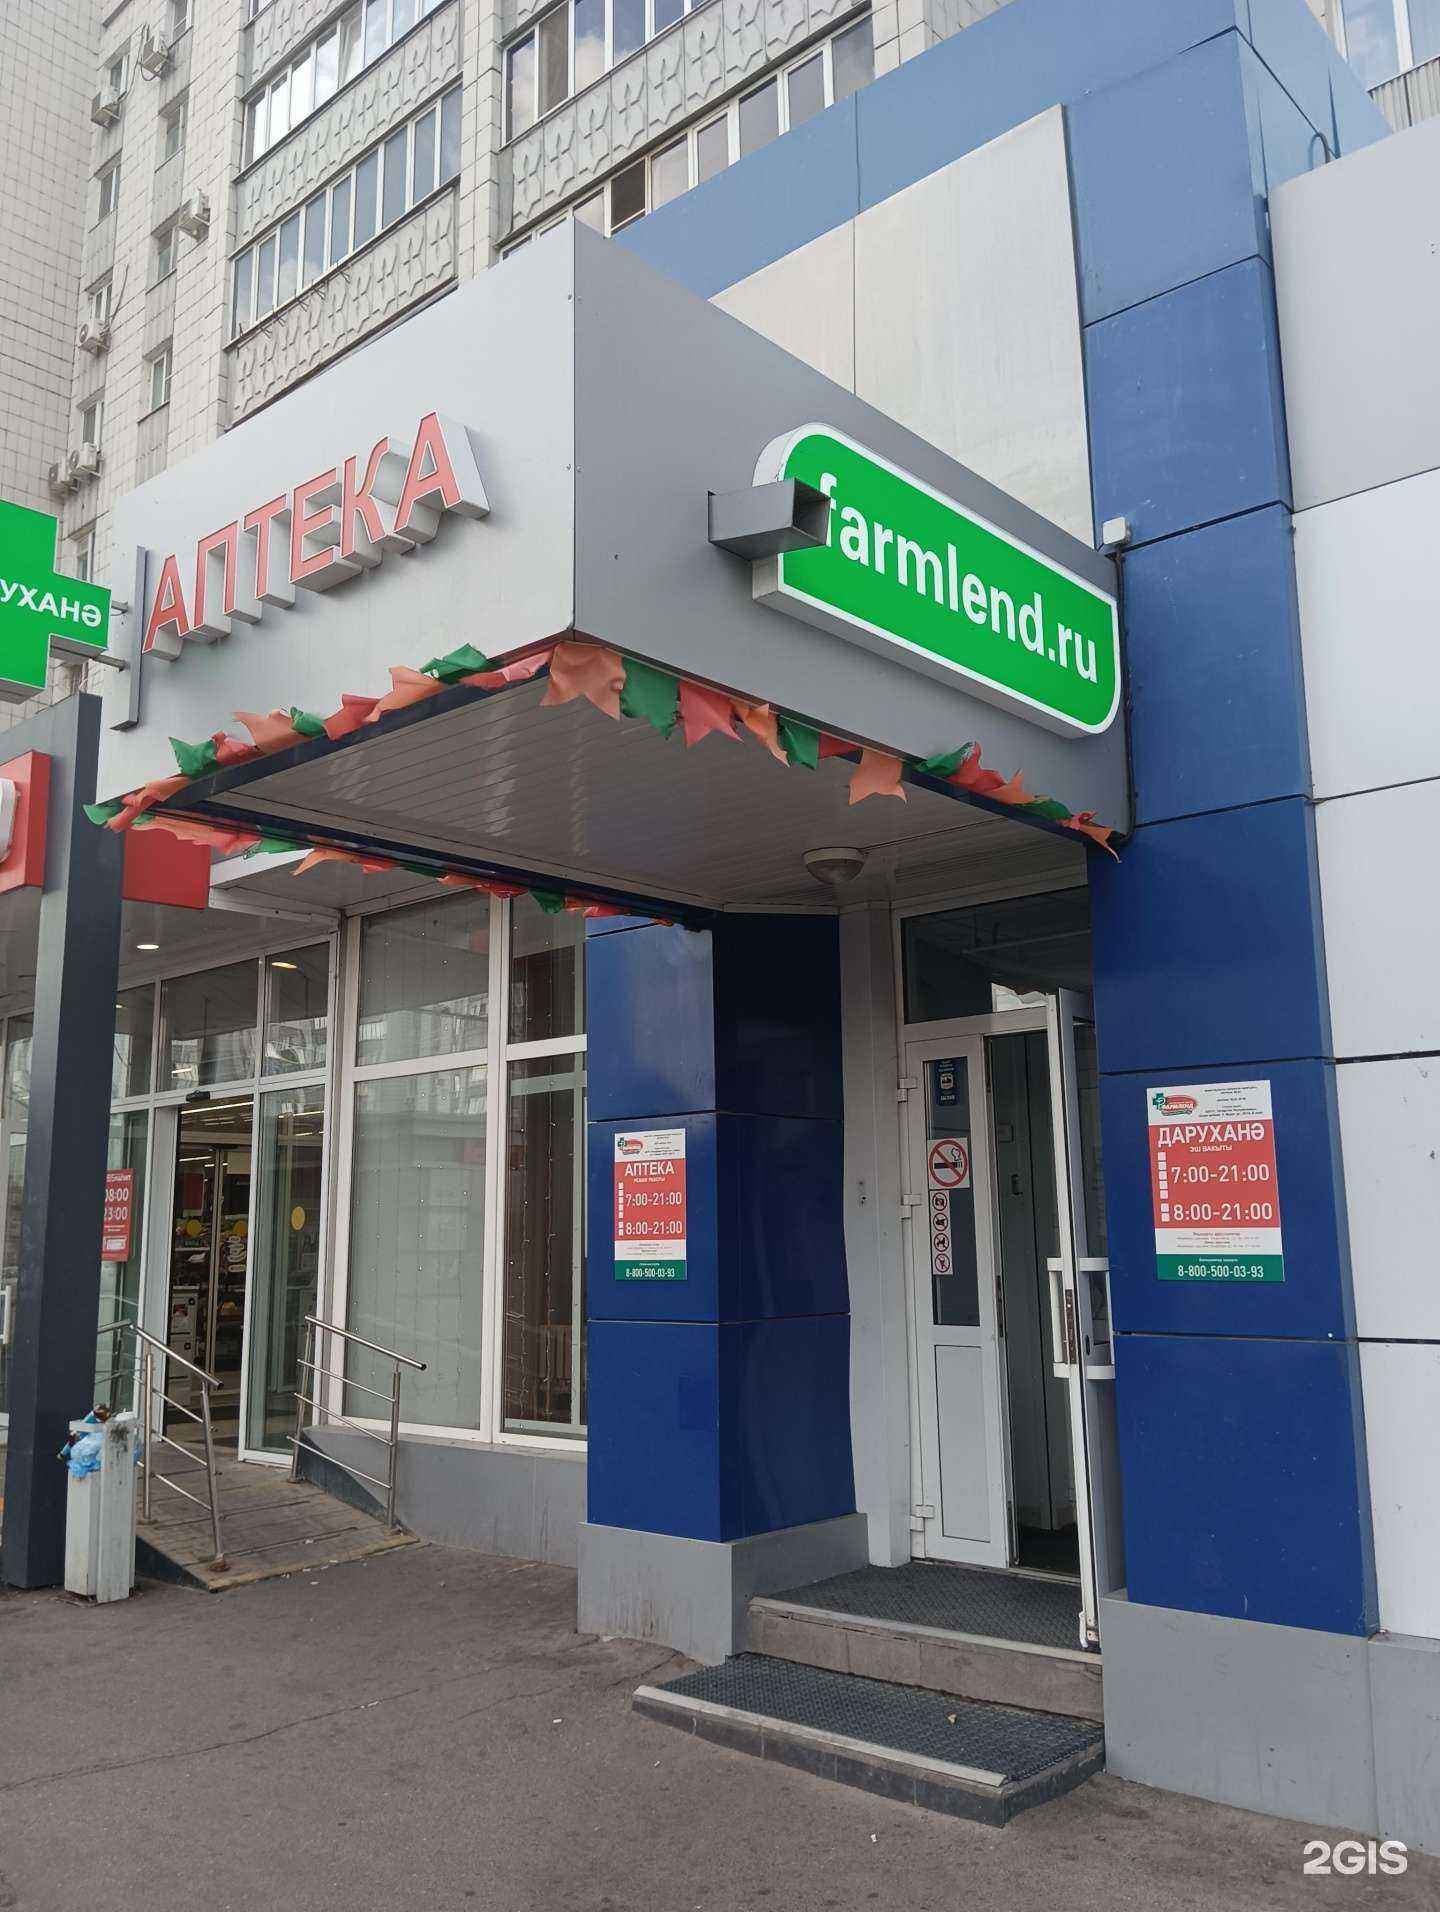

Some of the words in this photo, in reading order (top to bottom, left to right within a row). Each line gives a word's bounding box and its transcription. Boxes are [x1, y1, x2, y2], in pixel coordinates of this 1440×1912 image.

[142, 410, 463, 655] АПТЕКА
[1158, 1122, 1265, 1148] ДАРУХАНӘ
[624, 1161, 675, 1177] АПТЕКА
[1171, 1163, 1270, 1184] 7:00-21:00
[625, 1191, 682, 1207] 7:00-21:00
[1173, 1202, 1273, 1221] 8:00-21:00
[625, 1220, 683, 1235] 8:00-21:00
[1177, 1265, 1264, 1278] 8-800-500-03-93
